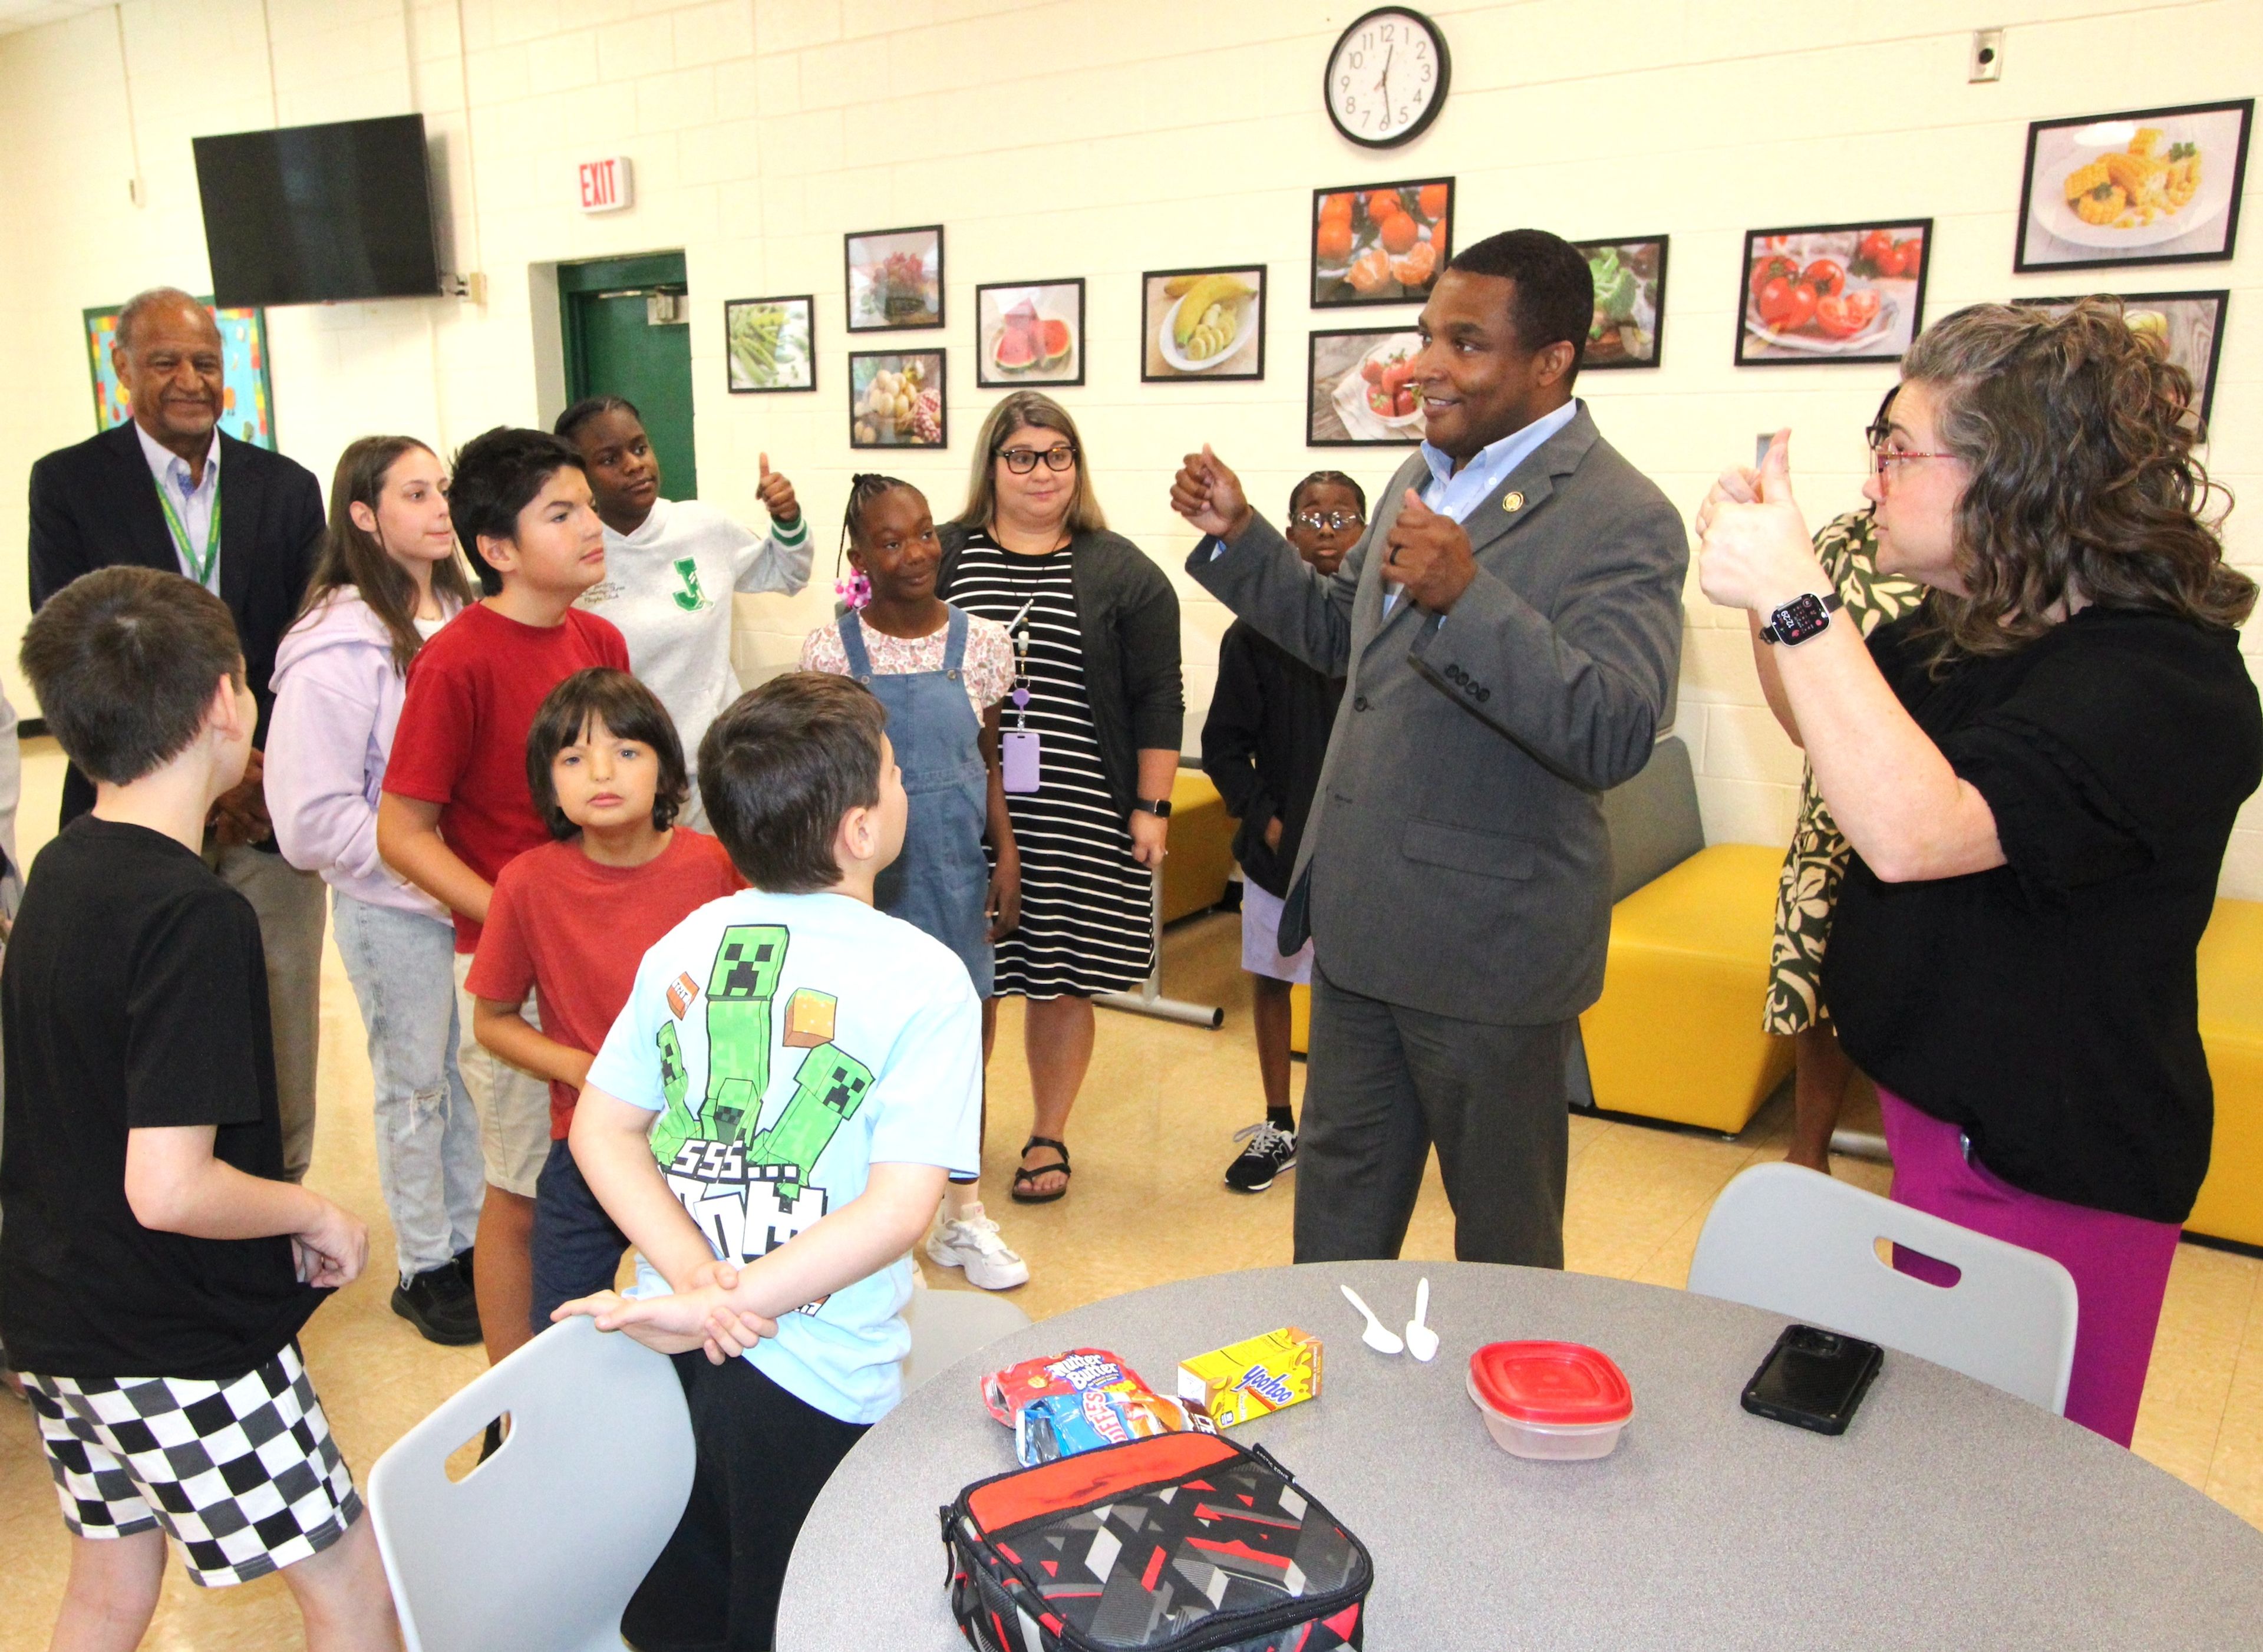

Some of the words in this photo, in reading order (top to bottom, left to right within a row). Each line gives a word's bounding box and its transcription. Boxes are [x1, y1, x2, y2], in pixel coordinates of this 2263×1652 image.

[1363, 33, 1373, 51] 11
[1380, 24, 1394, 42] 12
[1416, 41, 1426, 60] 2
[1349, 51, 1363, 70] 10
[1421, 64, 1431, 82] 3
[1341, 75, 1350, 93] 9
[1345, 96, 1355, 114] 8
[1413, 88, 1422, 105] 4
[1362, 110, 1371, 128] 7
[1379, 115, 1390, 131] 6
[1398, 106, 1408, 124] 5
[579, 160, 615, 207] EXIT
[1780, 610, 1794, 629] 12:29
[1044, 1354, 1103, 1377] Nutter
[1065, 1363, 1119, 1391] Butter
[1086, 1391, 1127, 1442] UFFLES
[1256, 1450, 1274, 1468] ARCTIC
